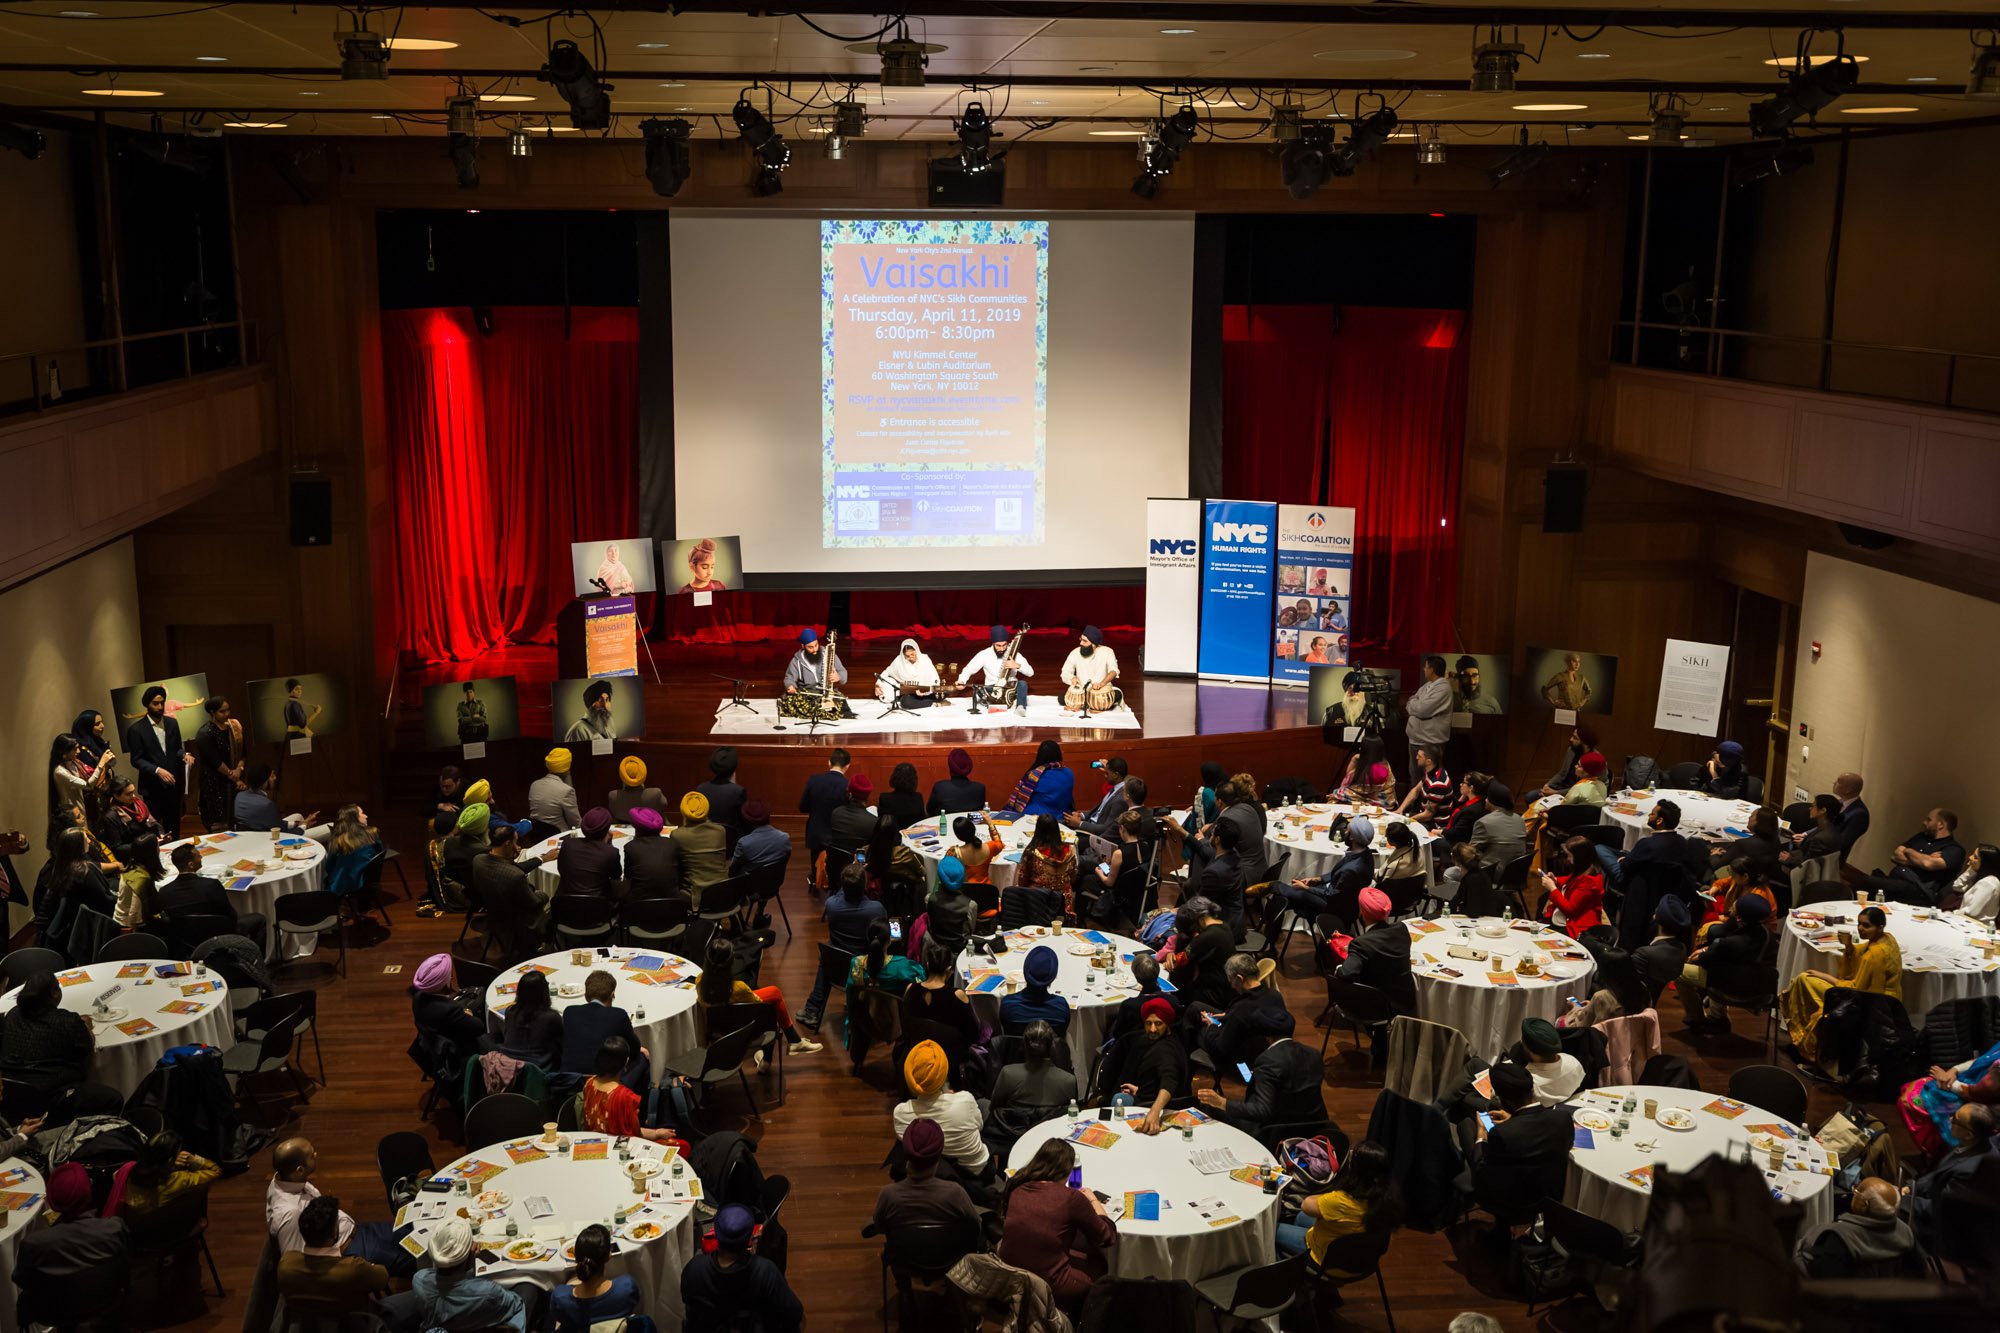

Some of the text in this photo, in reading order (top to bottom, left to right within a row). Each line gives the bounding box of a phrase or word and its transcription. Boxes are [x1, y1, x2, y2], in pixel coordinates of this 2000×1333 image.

[860, 255, 1009, 289] Vaisakhi
[843, 294, 1027, 303] A Celebration of NYC's Sikh Communities
[849, 308, 1021, 324] Thursday, April 11, 2019
[942, 327, 994, 342] 8:30pm
[893, 351, 977, 359] NYU Kimmel Center
[872, 372, 998, 382] 60 Washington Square South
[912, 383, 934, 391] York,
[849, 396, 872, 404] RSVP
[890, 418, 927, 426] Entrance
[837, 486, 870, 498] NYC
[1212, 522, 1268, 544] NYC
[1282, 534, 1350, 544] SIKHCOALITION
[1150, 539, 1196, 555] NYC
[1212, 545, 1266, 555] HUMAN RIGHTS
[594, 623, 628, 632] Vaisakhi
[1682, 656, 1709, 667] SIKH
[100, 985, 121, 1001] RESERVED
